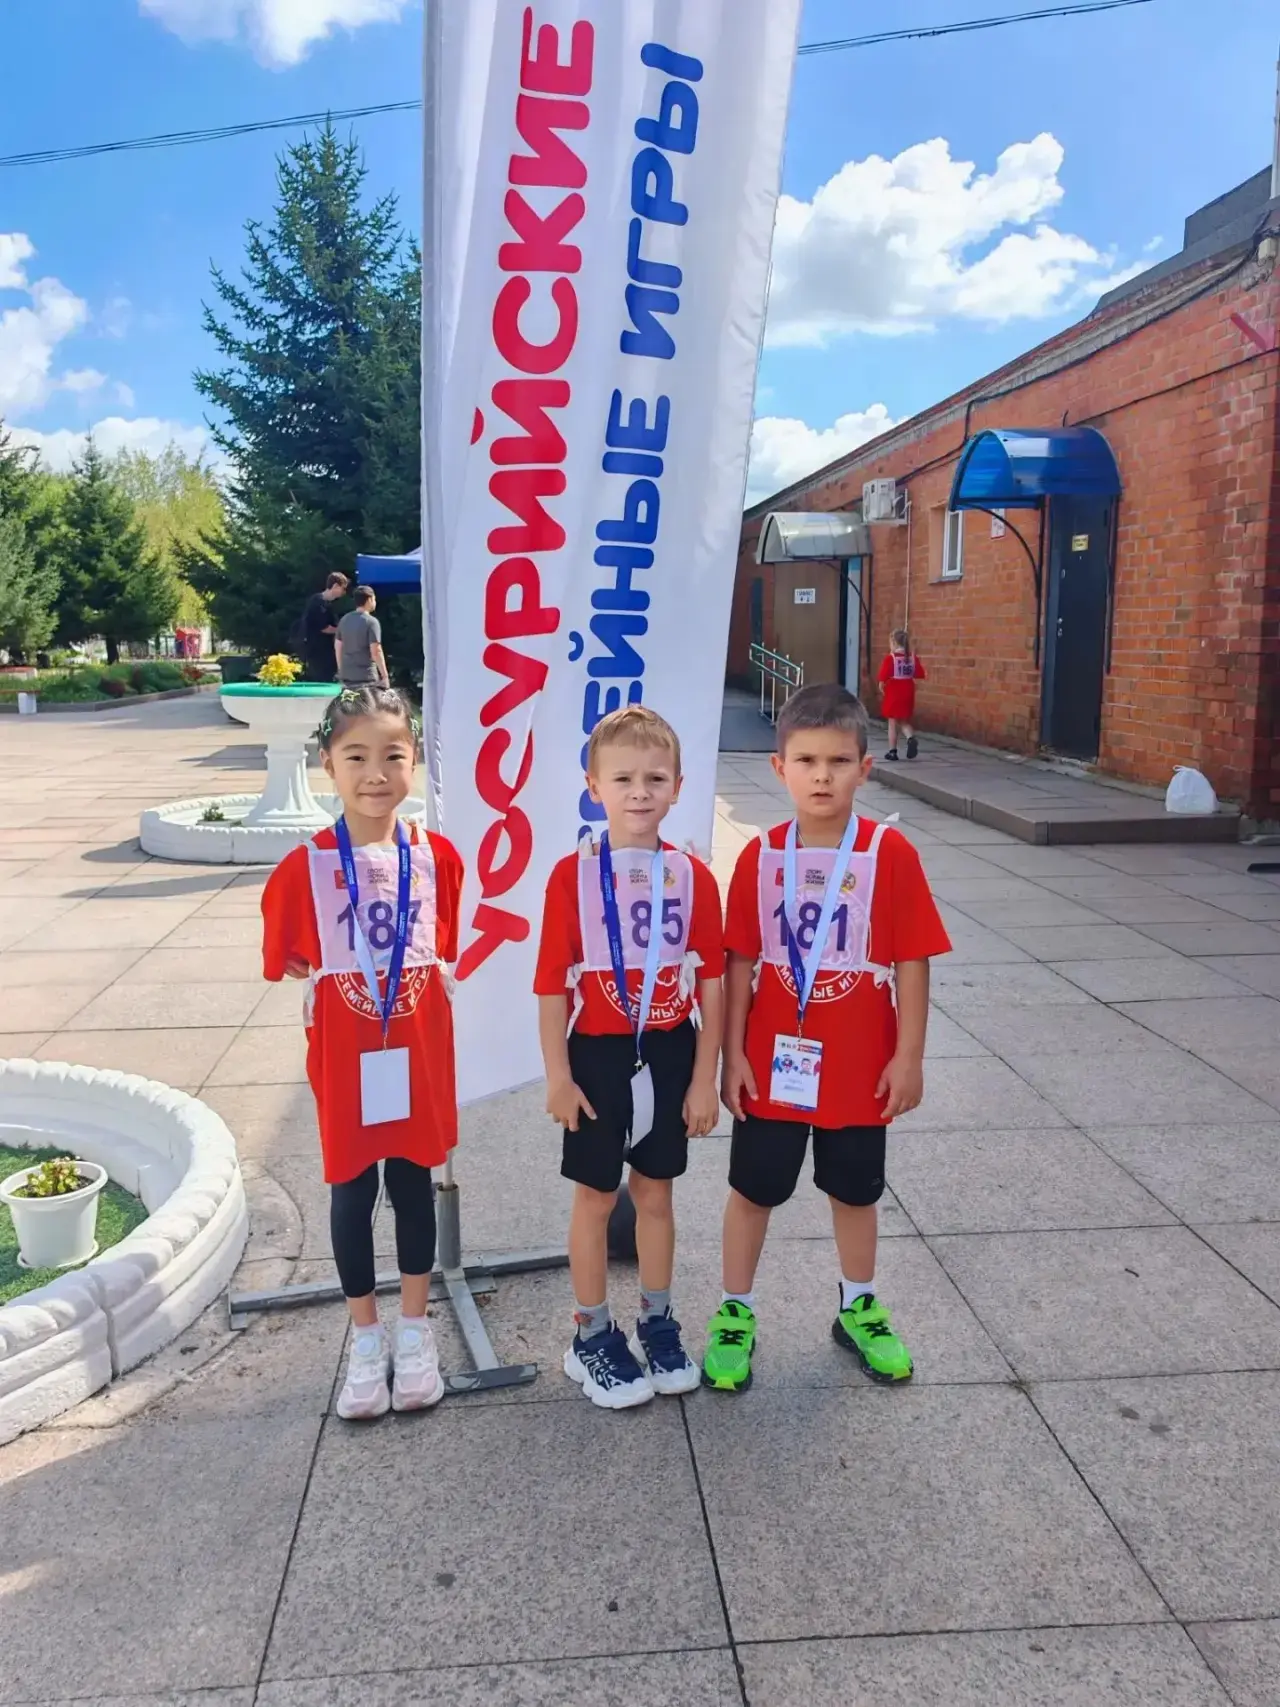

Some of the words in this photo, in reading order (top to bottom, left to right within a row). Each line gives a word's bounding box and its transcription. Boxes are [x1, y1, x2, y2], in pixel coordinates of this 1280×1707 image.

[619, 42, 704, 361] ИГРЫ
[601, 898, 685, 949] 85
[773, 899, 849, 953] 181
